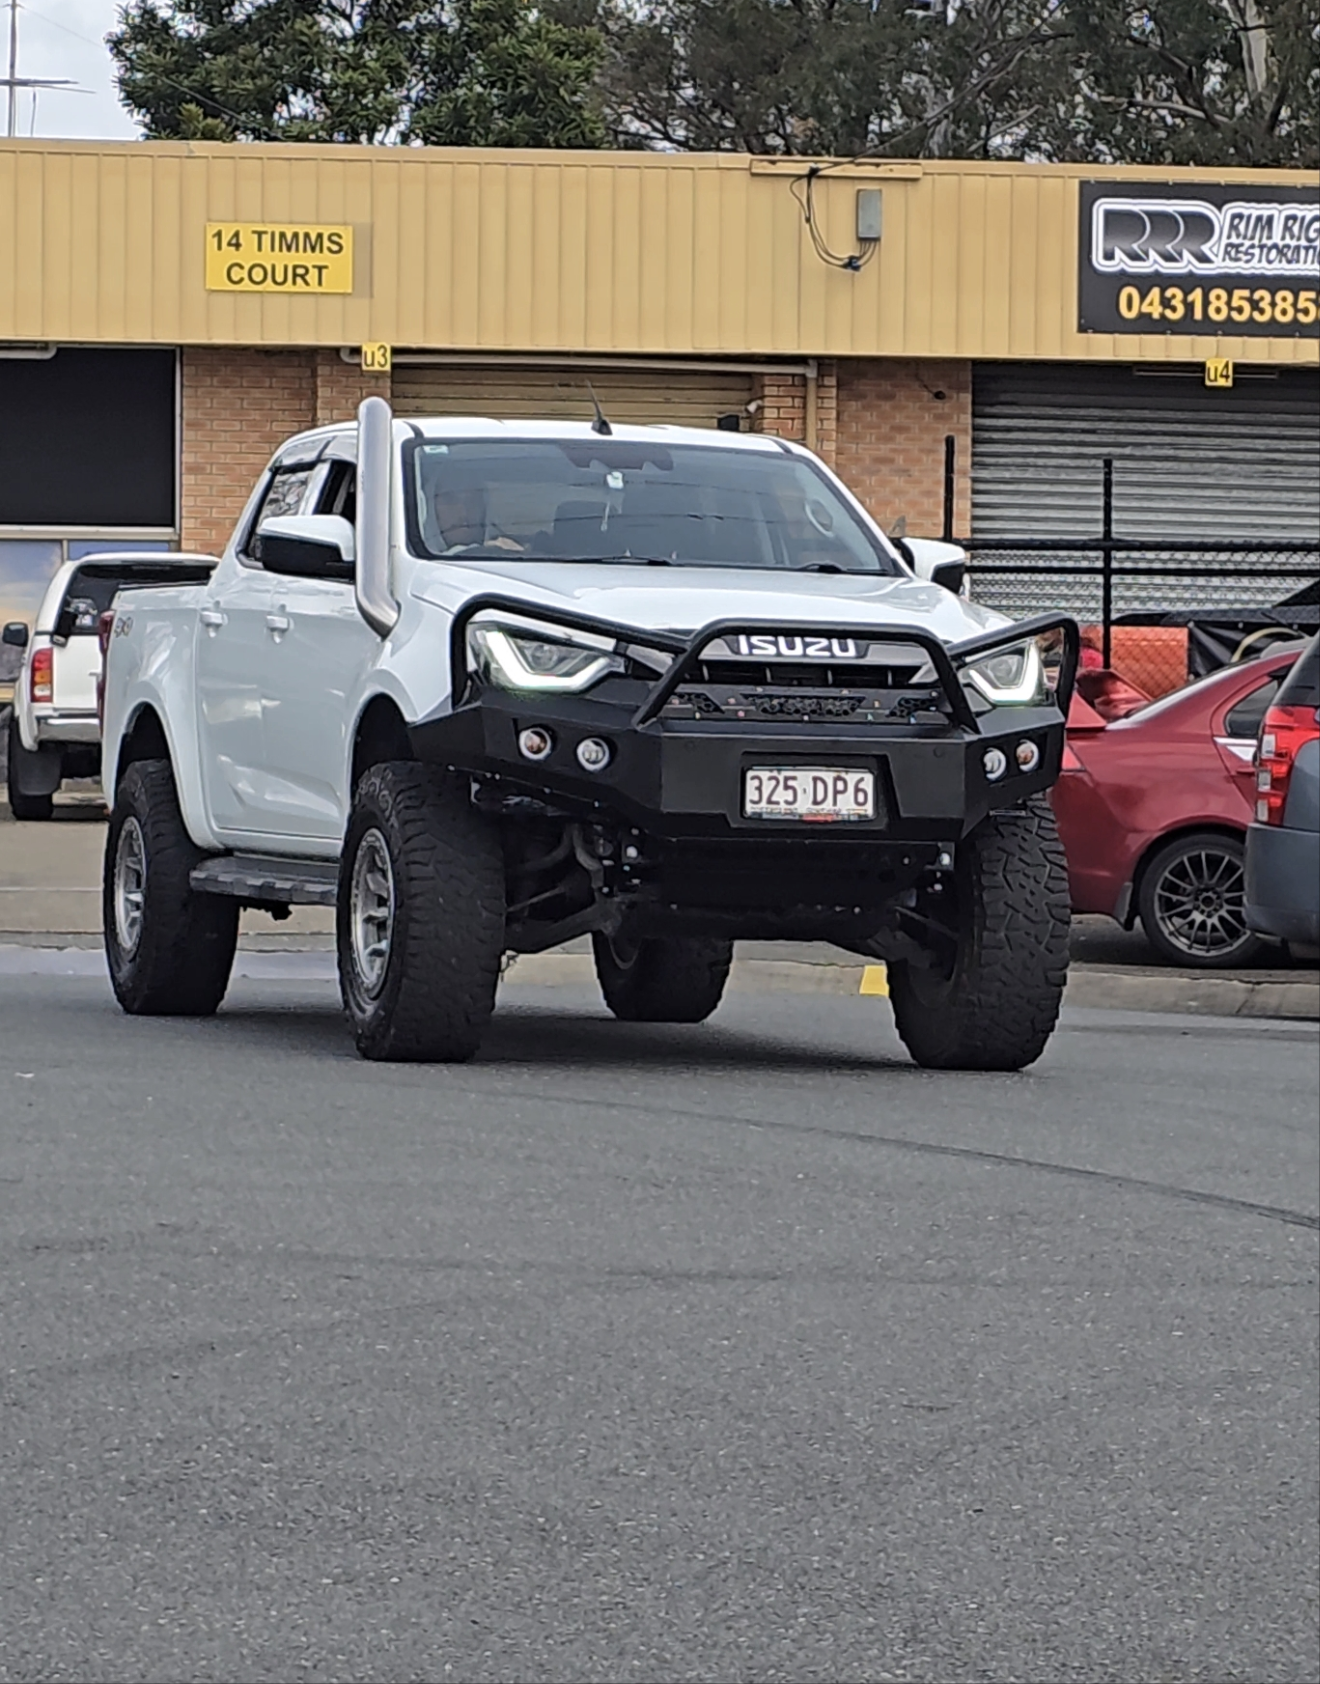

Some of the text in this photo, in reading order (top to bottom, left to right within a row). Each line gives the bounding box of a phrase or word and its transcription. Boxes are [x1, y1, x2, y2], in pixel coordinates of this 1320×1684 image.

[1102, 207, 1218, 265] RRR
[1226, 212, 1275, 243] RIM
[211, 229, 344, 255] 14 TIMMS
[1221, 242, 1320, 265] RESTORATI
[226, 262, 329, 287] COURT
[1118, 286, 1320, 324] 043185385
[364, 344, 388, 368] u3
[1207, 359, 1231, 383] u4
[738, 634, 857, 657] ISUZU
[749, 775, 868, 807] 325 DP6
